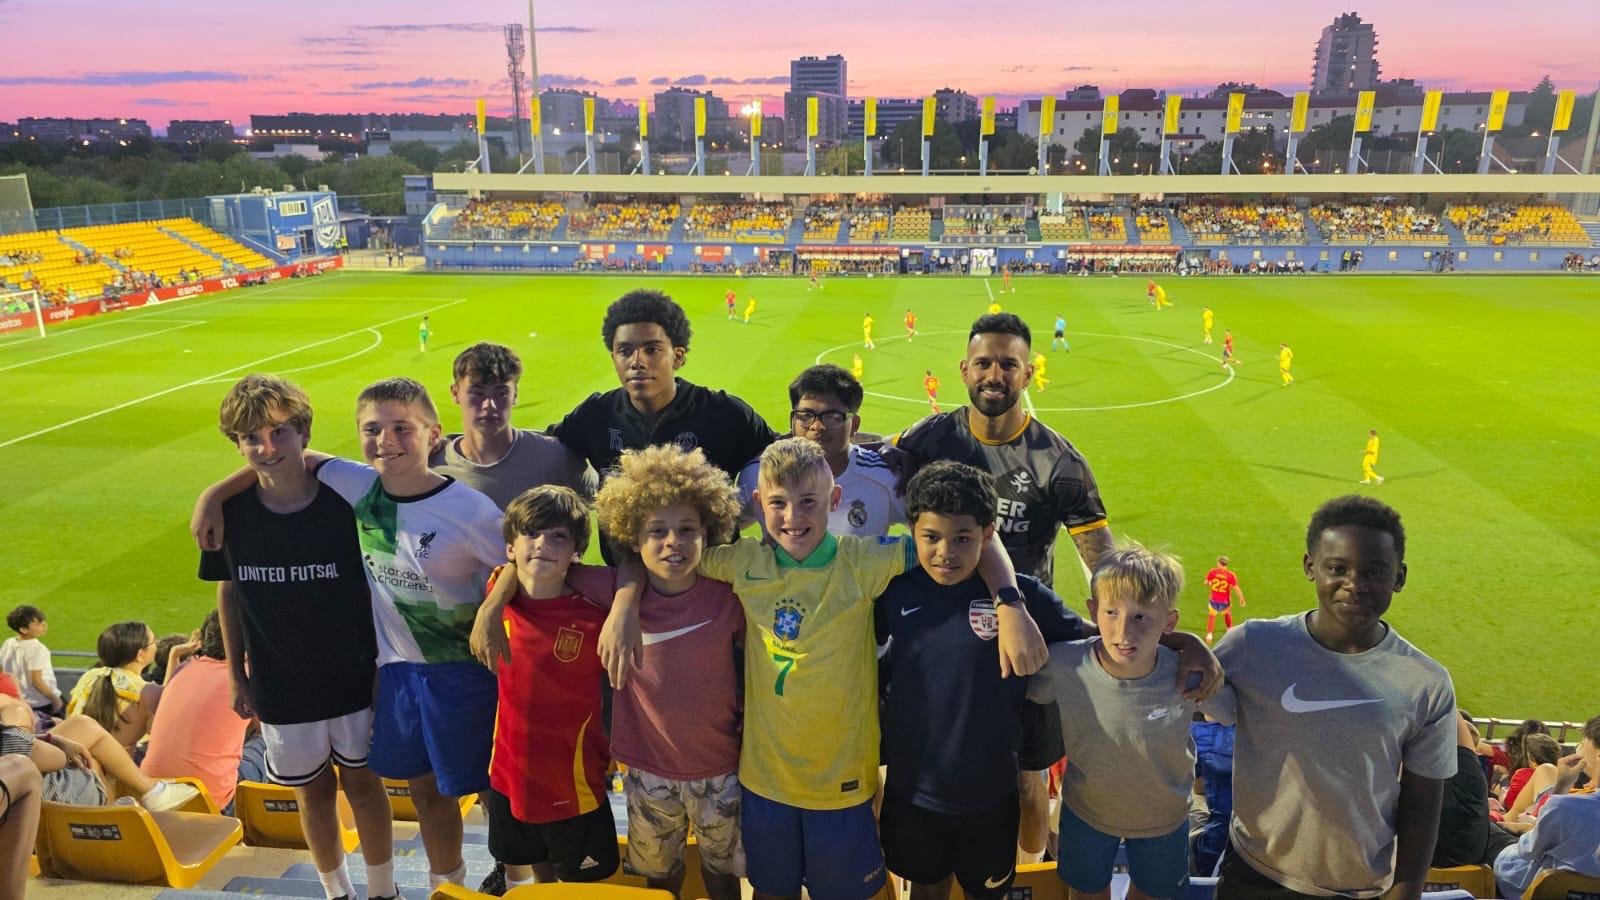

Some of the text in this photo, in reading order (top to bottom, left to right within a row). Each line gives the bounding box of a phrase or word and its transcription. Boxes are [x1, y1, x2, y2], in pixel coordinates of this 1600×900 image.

[177, 285, 204, 296] EBRO
[221, 278, 239, 288] TCL
[50, 306, 75, 320] renfe
[997, 497, 1027, 518] ER
[996, 516, 1030, 533] NG
[238, 563, 339, 582] UNITED FUTSAL
[379, 565, 428, 583] standard
[1211, 577, 1228, 592] 22
[773, 653, 794, 696] 7
